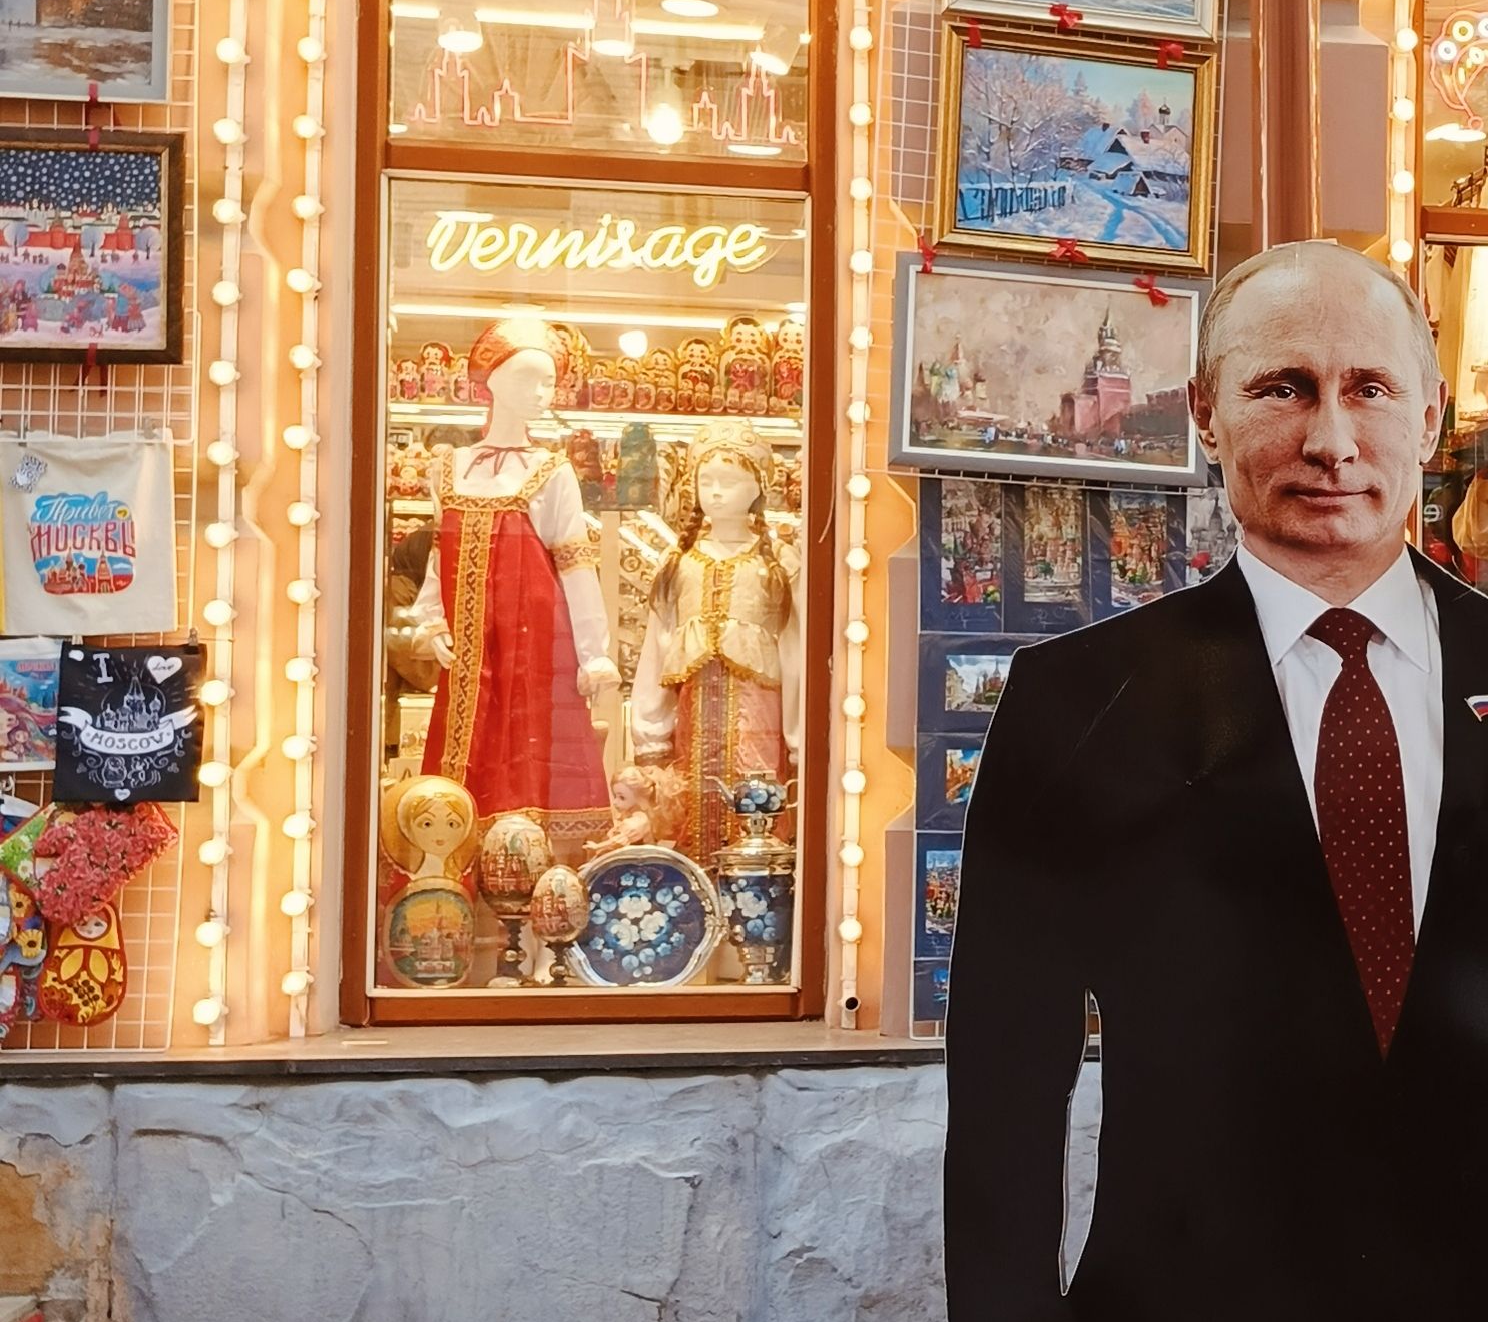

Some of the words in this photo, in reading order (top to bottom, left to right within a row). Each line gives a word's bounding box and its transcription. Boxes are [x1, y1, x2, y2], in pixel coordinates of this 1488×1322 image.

[427, 210, 767, 288] Vernisage
[30, 521, 136, 562] МОСКВЫ
[90, 731, 164, 751] MOSCOW
